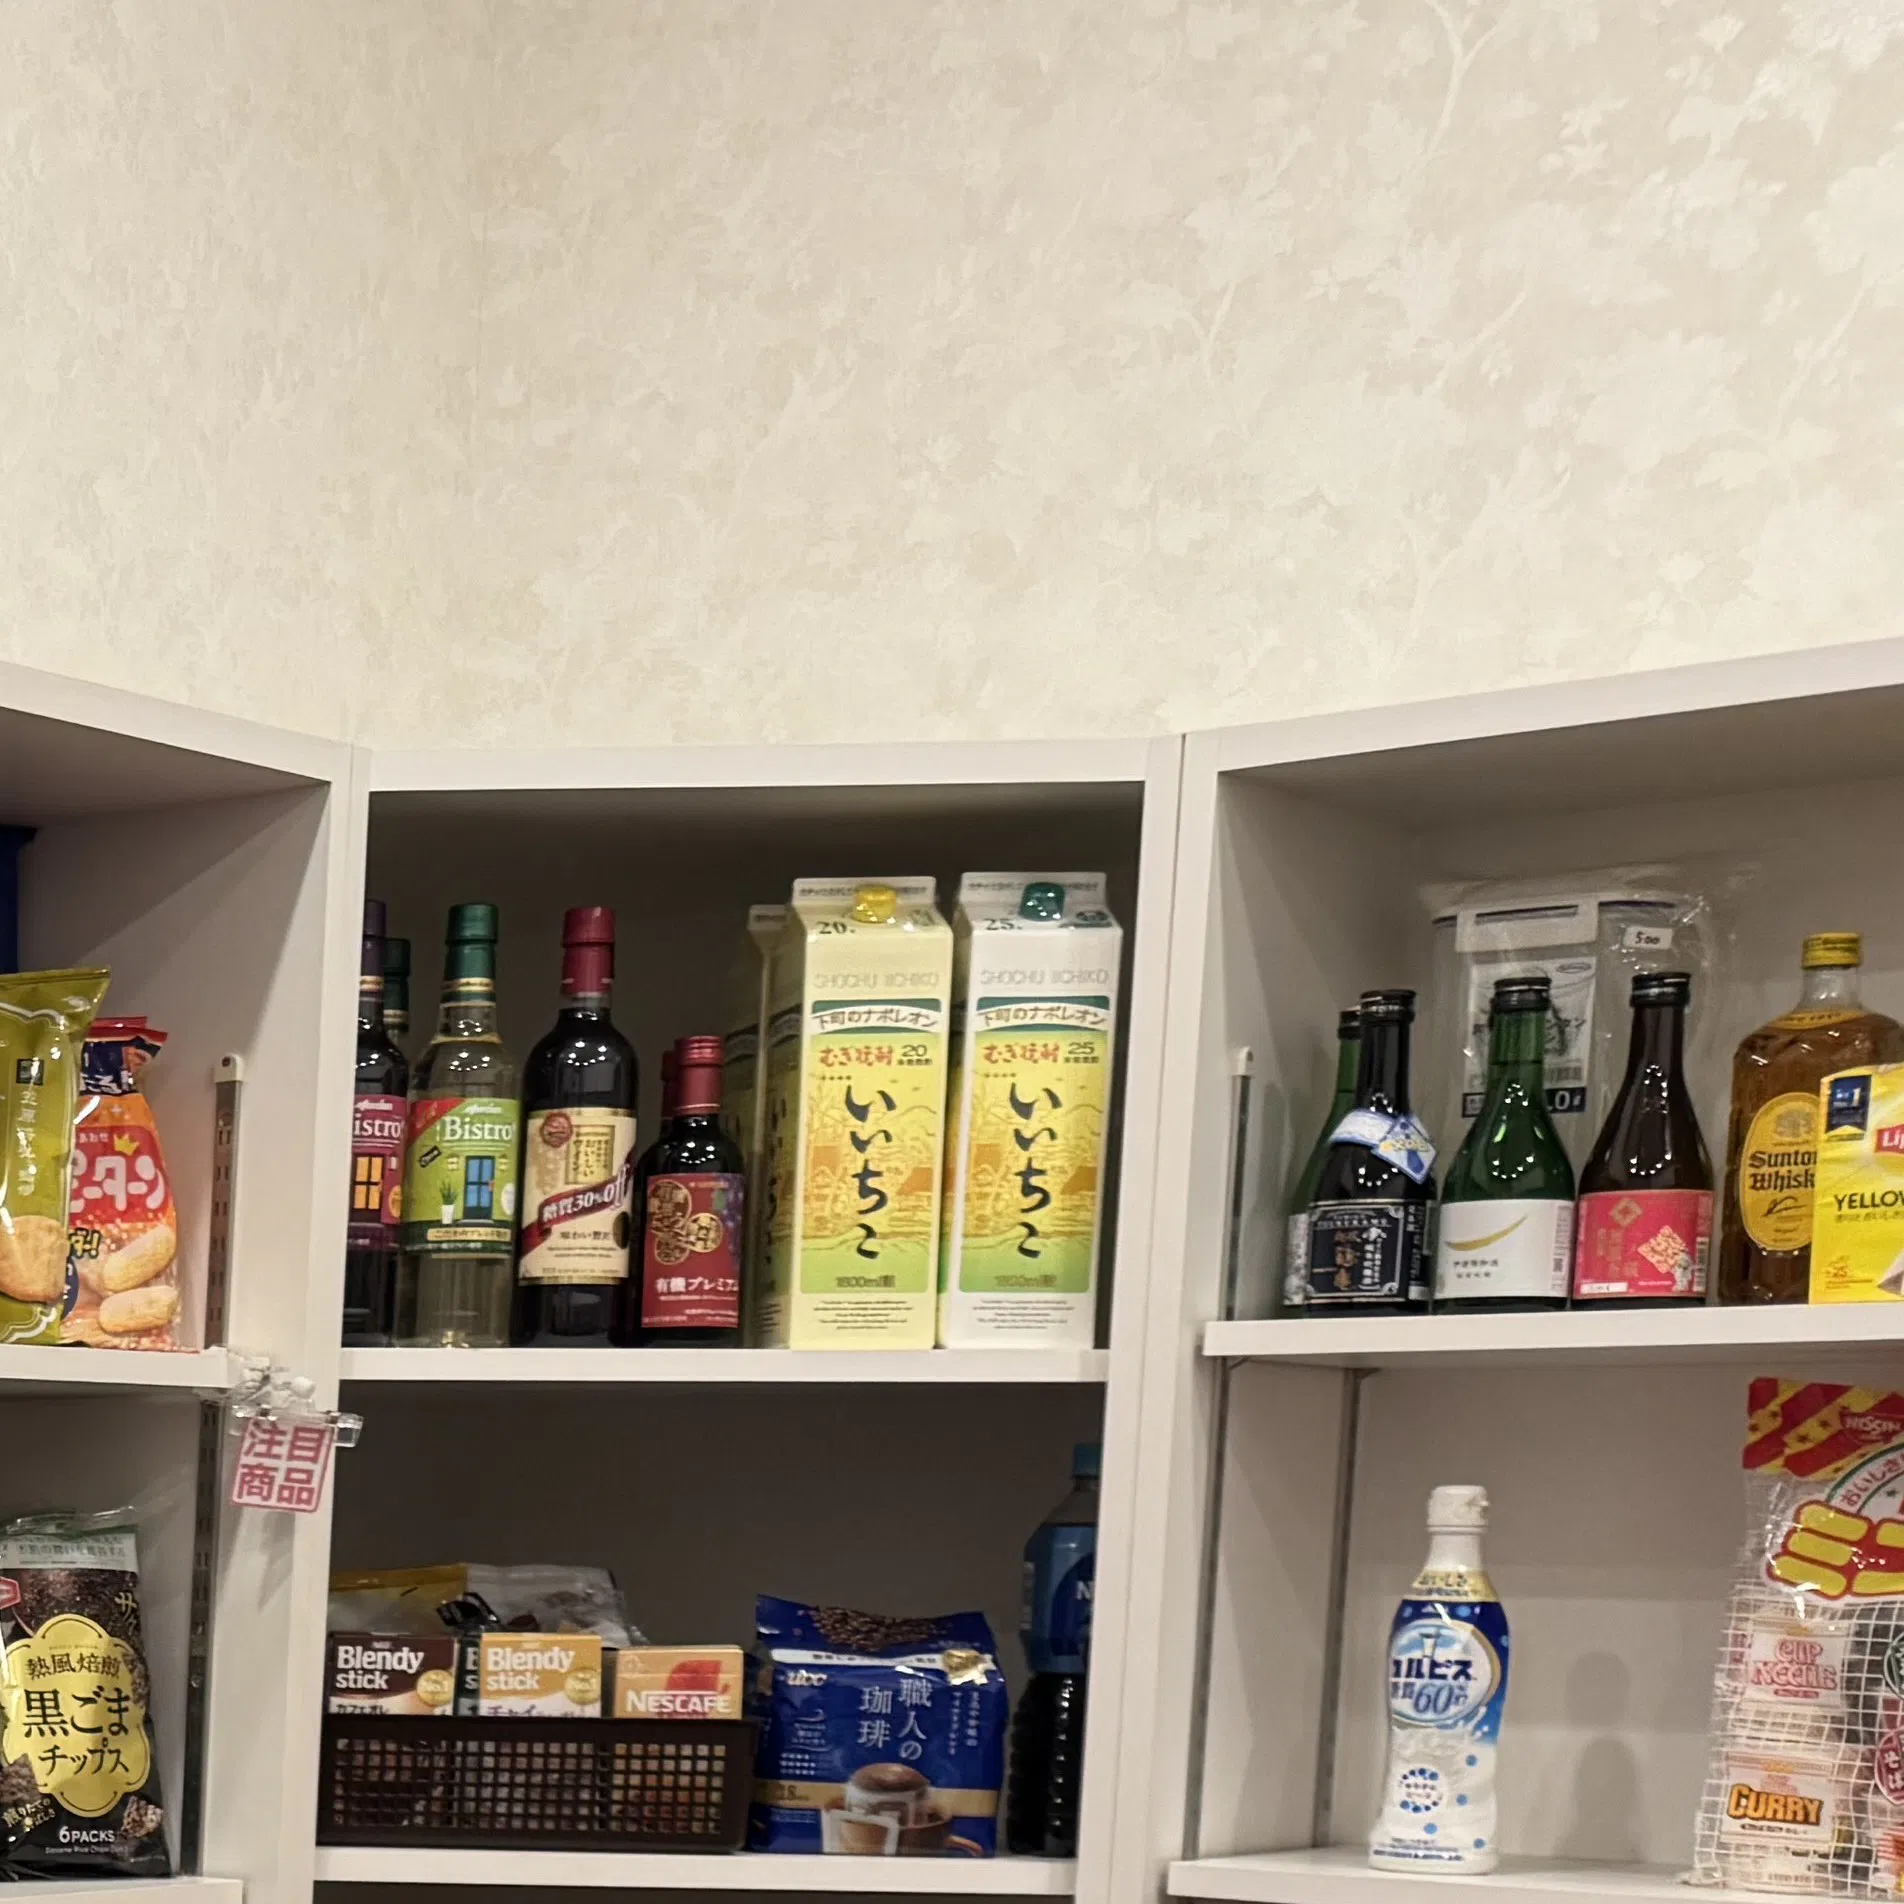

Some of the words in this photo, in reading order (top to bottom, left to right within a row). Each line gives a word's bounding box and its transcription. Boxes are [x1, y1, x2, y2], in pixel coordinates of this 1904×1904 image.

[816, 1006, 938, 1029] 下町のナポレオン
[982, 1005, 1106, 1027] 下町のナポレオン
[1068, 1042, 1096, 1055] 25
[441, 1118, 513, 1142] Bistro
[844, 1082, 897, 1260] いいちこ
[1009, 1082, 1062, 1259] いいちこ
[244, 1419, 327, 1464] 注目
[238, 1463, 315, 1505] 商品
[26, 1654, 122, 1681] 熱風焙煎
[337, 1647, 424, 1674] Blendy
[487, 1647, 575, 1672] Blendy
[336, 1672, 388, 1690] stick
[486, 1671, 539, 1690] stick
[1415, 1682, 1451, 1711] 60
[23, 1689, 129, 1740] 黒ごま
[859, 1687, 892, 1749] 珈琲
[899, 1679, 932, 1759] 職人の
[37, 1738, 130, 1777] チップス
[1727, 1783, 1824, 1826] CURRY
